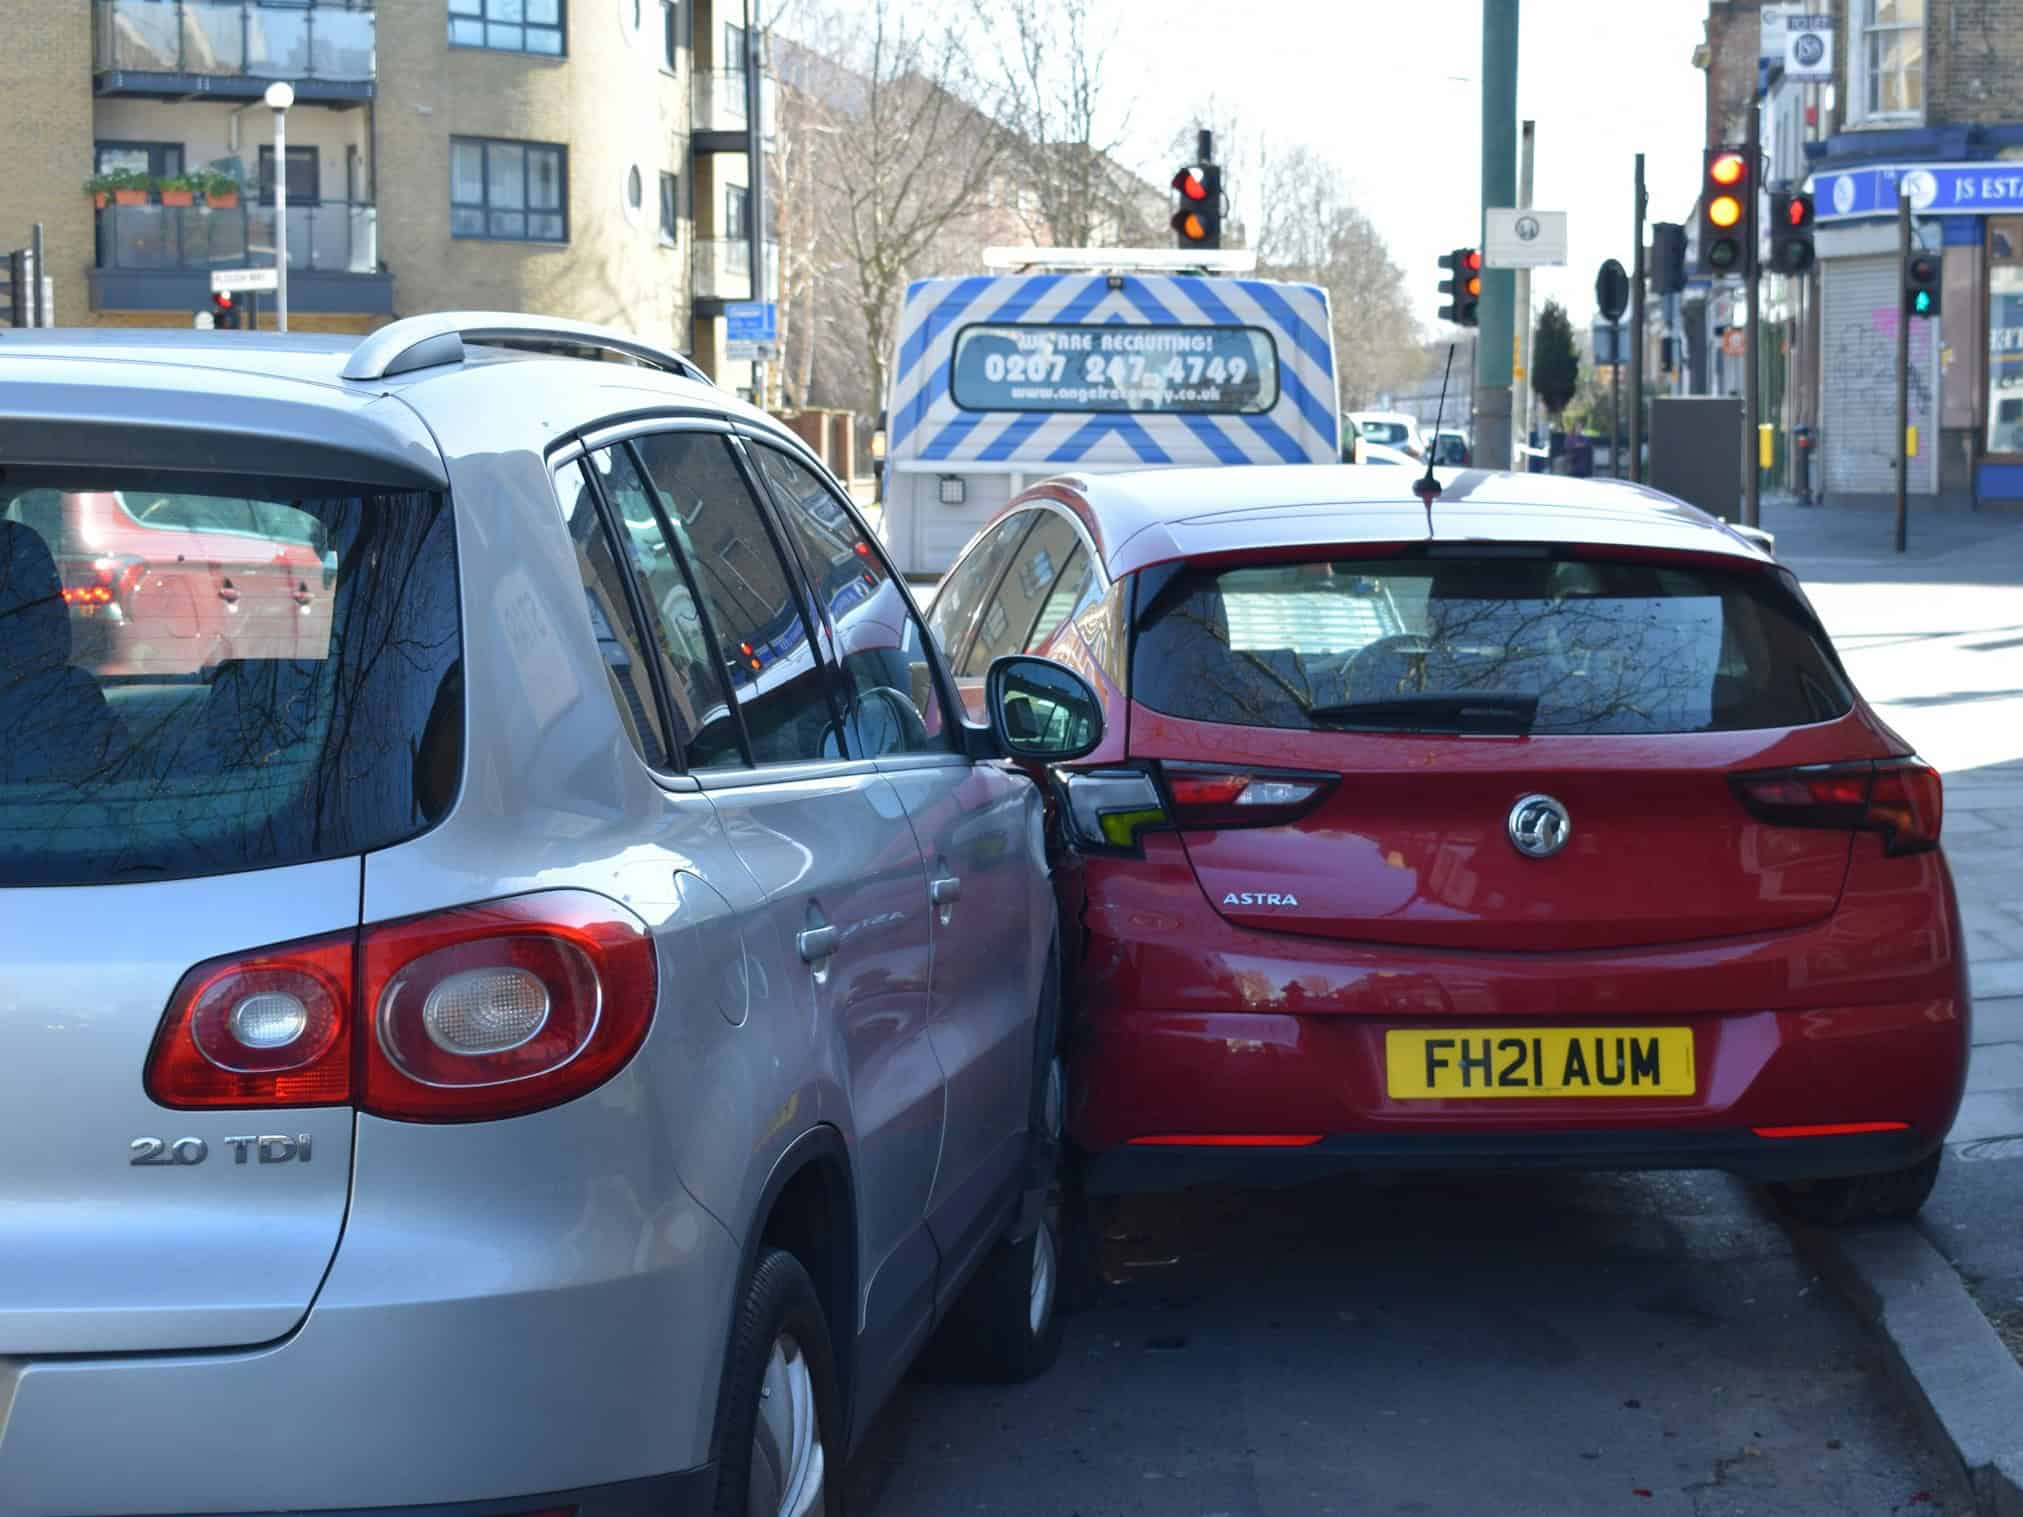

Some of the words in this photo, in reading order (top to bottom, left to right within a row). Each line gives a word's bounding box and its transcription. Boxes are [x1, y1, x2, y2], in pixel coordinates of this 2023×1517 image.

[1954, 176, 1975, 204] JS
[1057, 334, 1092, 350] ARE
[1101, 334, 1214, 352] RECRUITING!
[984, 354, 1067, 382] 0207
[1085, 354, 1146, 383] 247
[1167, 356, 1248, 385] 4749
[1223, 892, 1299, 906] ASTRA
[1424, 1037, 1543, 1088] FH21
[1562, 1037, 1661, 1087] AUM
